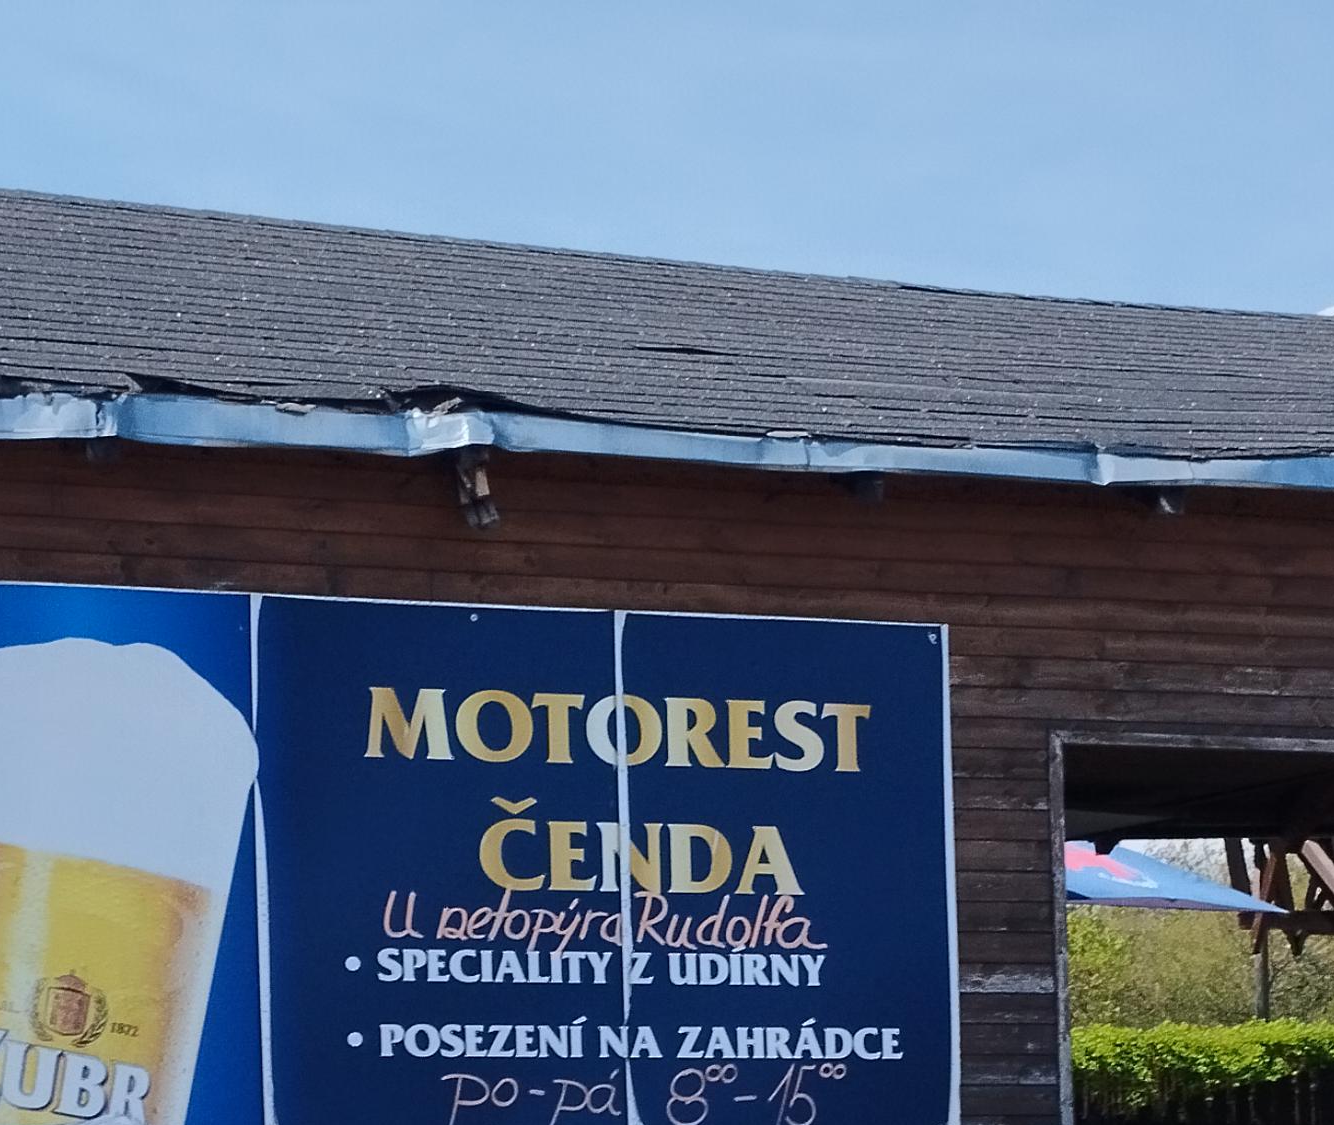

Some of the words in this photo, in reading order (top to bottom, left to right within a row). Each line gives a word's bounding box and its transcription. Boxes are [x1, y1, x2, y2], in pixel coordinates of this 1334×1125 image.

[364, 686, 872, 772] MOTOREST
[479, 796, 806, 896] ČENDA
[383, 890, 424, 940] U
[435, 886, 624, 959] netopýra
[631, 890, 828, 950] Rudolfa
[377, 947, 614, 986] SPECIALITY
[628, 950, 655, 985] Z
[668, 944, 827, 988] UDÍRNY
[378, 1015, 585, 1060] POSEZENÍ
[598, 1024, 665, 1060] NA
[676, 1017, 905, 1061] ZAHRÁDCE
